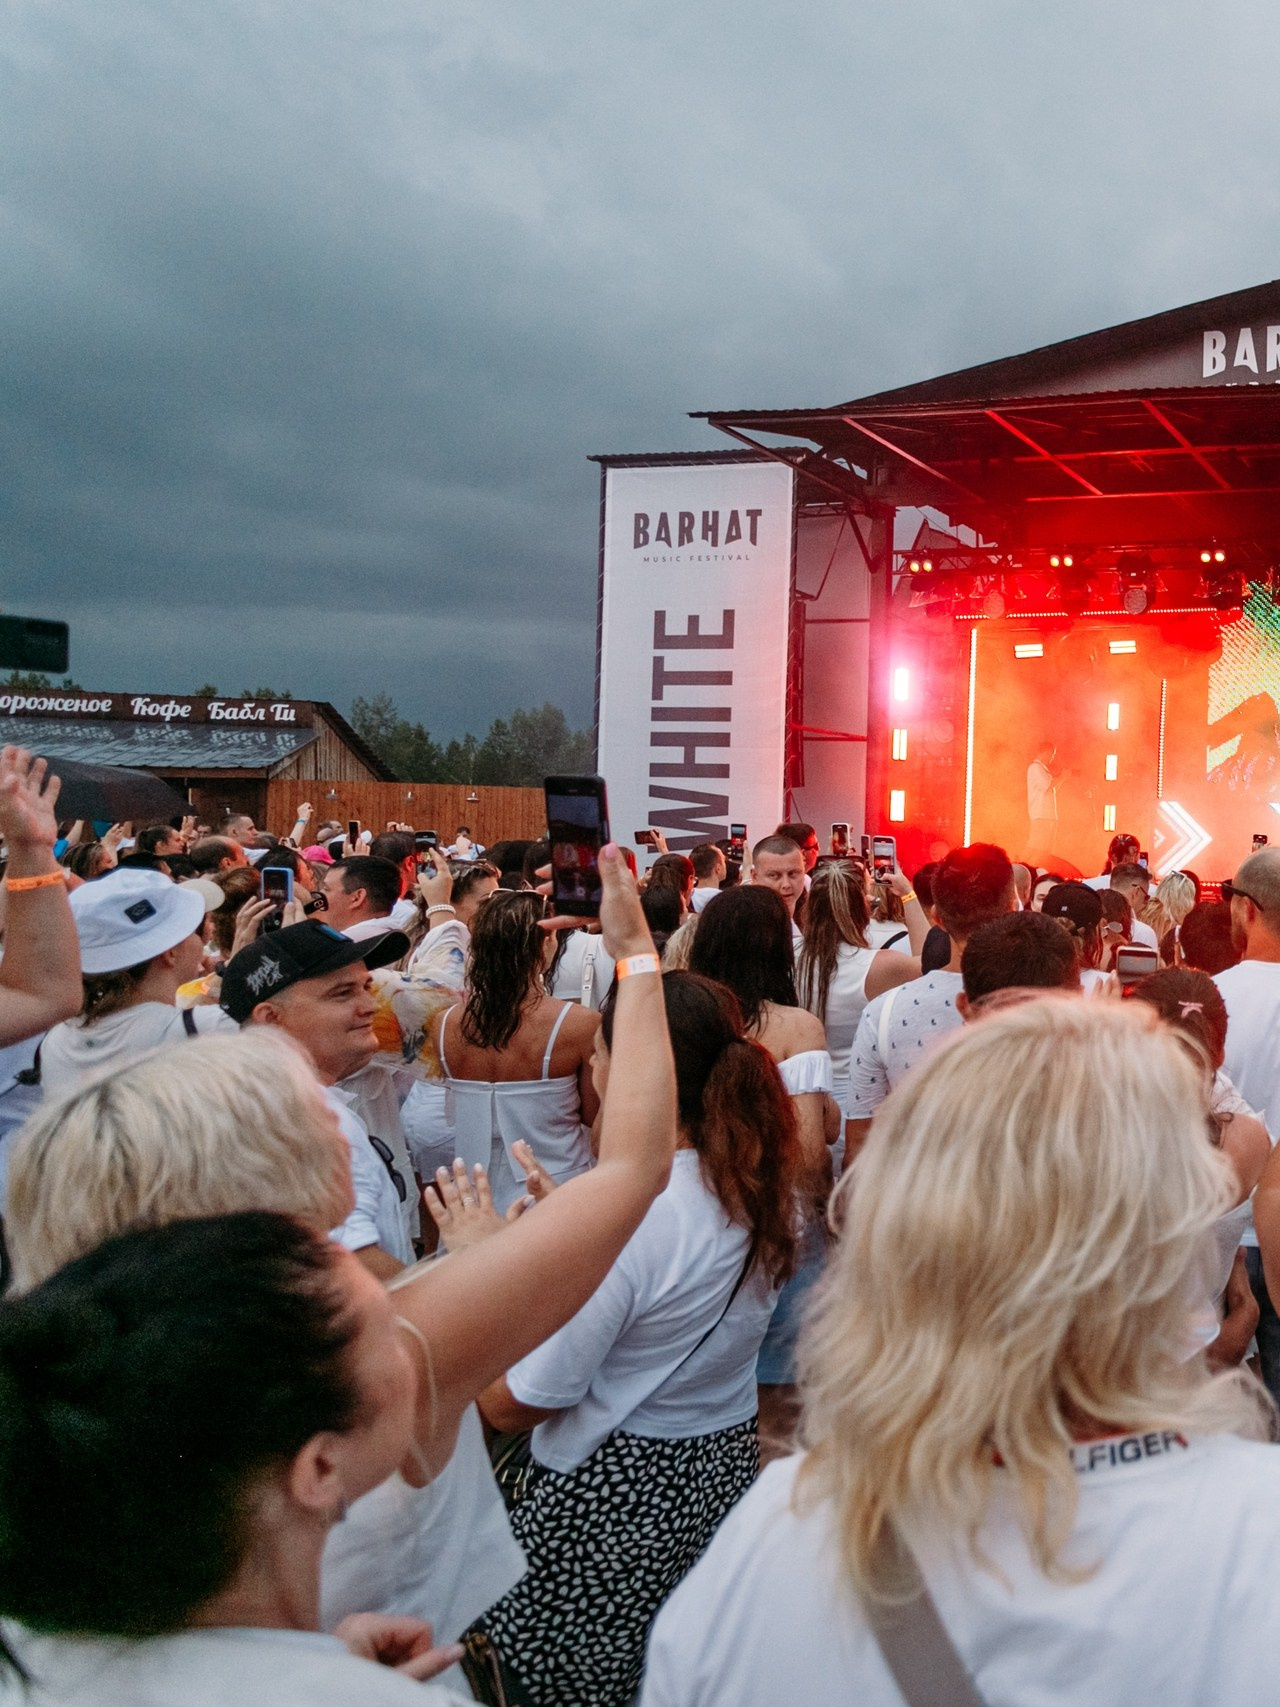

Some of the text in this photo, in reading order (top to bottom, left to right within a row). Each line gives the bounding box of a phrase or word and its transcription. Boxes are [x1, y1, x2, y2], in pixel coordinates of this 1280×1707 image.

[633, 509, 763, 549] BARHAT
[643, 554, 750, 563] MUSIC FESTIVAL
[0, 695, 296, 721] ороженое Кофе Бабл Ти
[647, 609, 735, 853] WHITE
[1069, 1430, 1188, 1472] LFIGER
